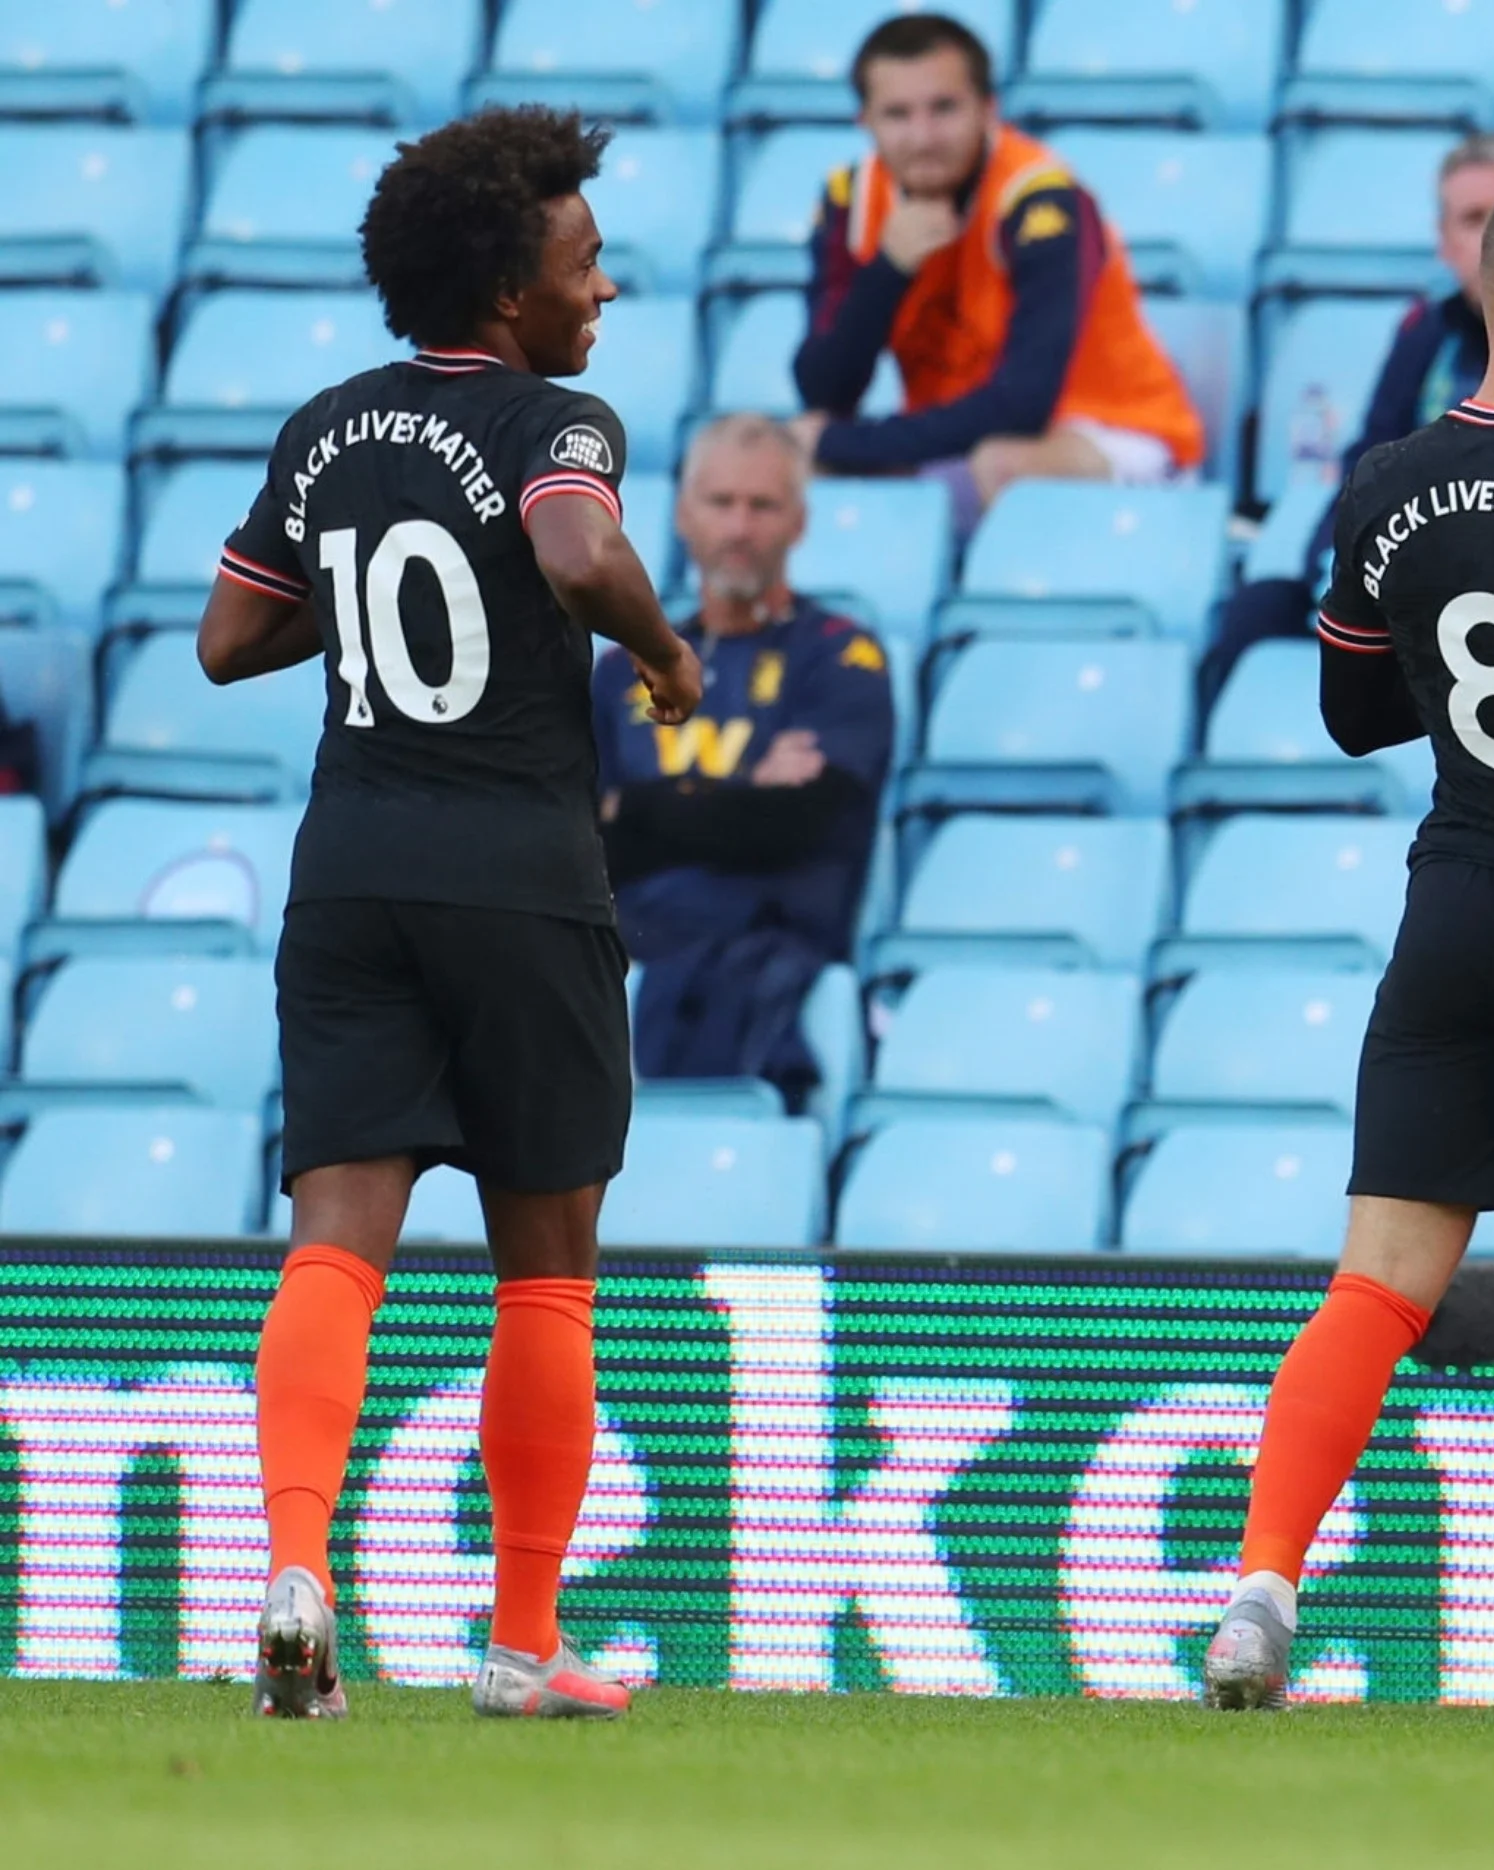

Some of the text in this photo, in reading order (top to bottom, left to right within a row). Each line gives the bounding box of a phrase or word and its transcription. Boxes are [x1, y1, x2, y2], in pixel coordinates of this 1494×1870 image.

[284, 409, 507, 543] BLACK LIVES MATTER
[1363, 496, 1428, 600] BLACK
[319, 519, 490, 727] 10
[655, 716, 754, 778] W
